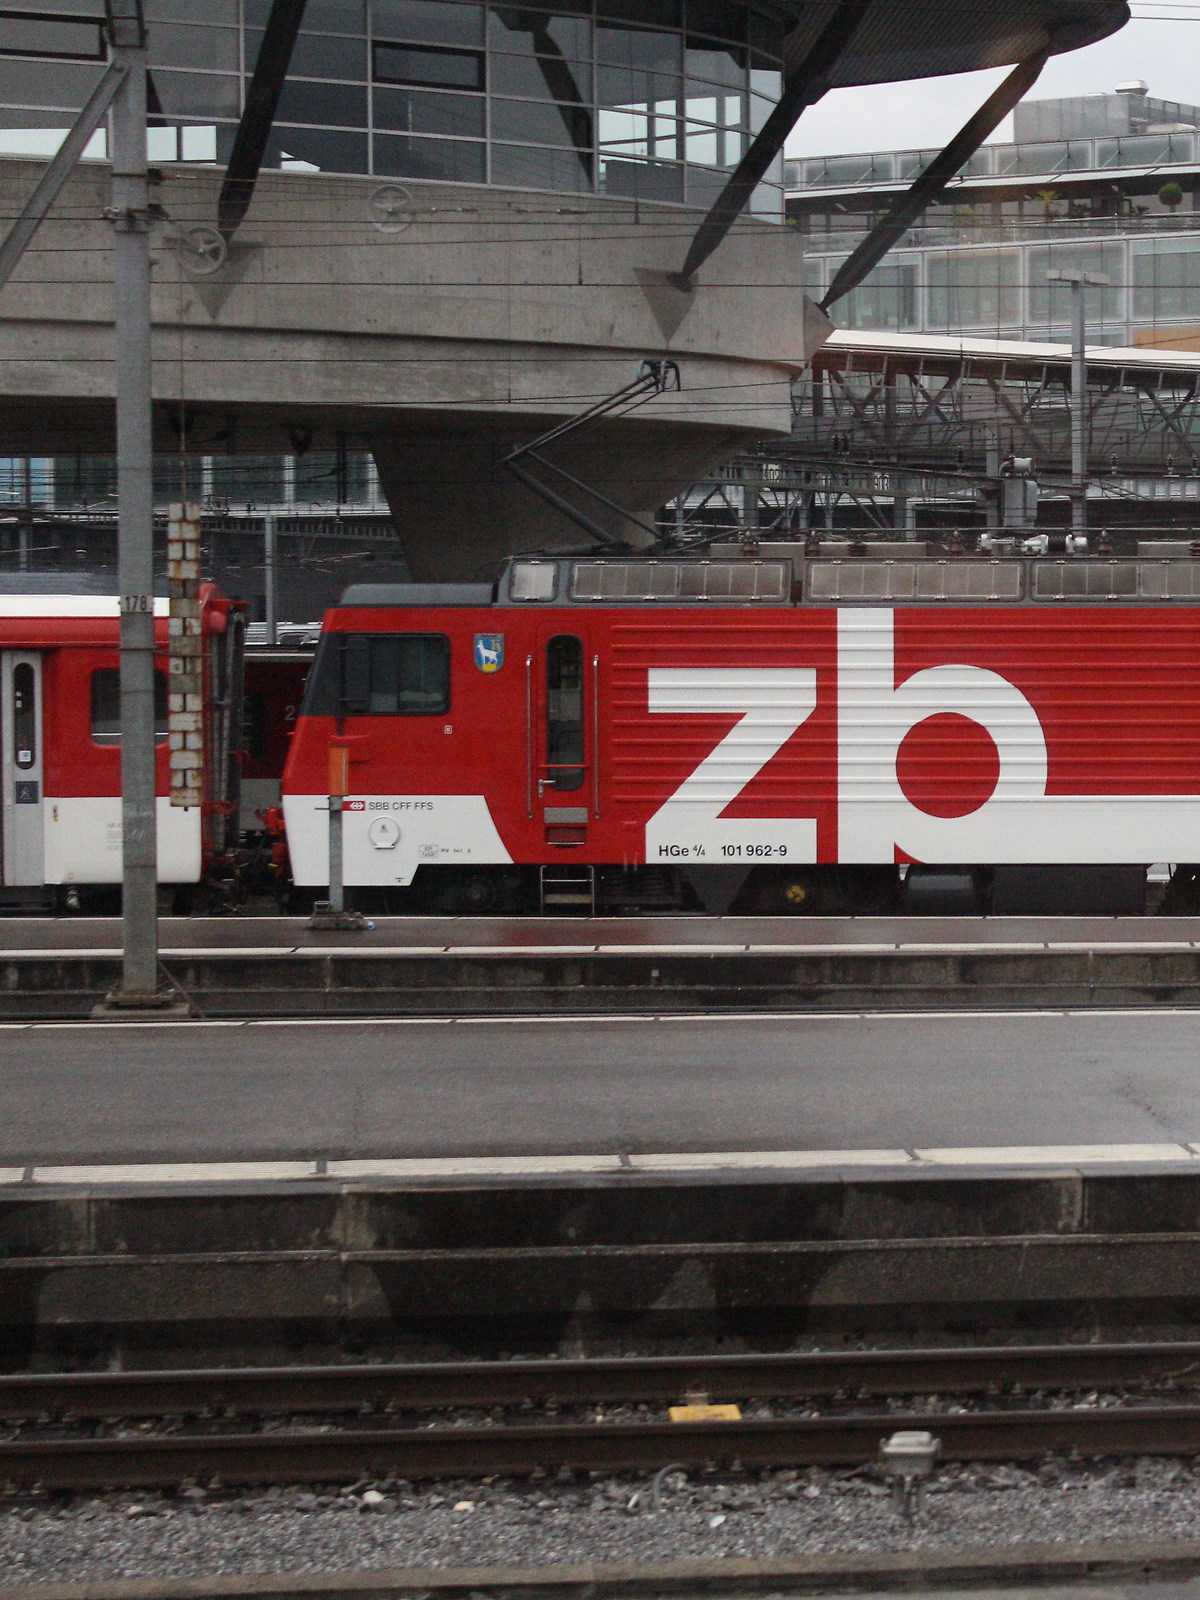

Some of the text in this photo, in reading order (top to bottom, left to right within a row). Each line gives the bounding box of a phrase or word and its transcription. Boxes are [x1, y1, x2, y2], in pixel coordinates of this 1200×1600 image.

[125, 595, 147, 611] 178
[645, 608, 1048, 864] zb
[369, 801, 434, 811] SBB CFF FFS
[658, 844, 690, 857] HGe
[721, 844, 742, 857] 101
[745, 844, 788, 857] 962-9
